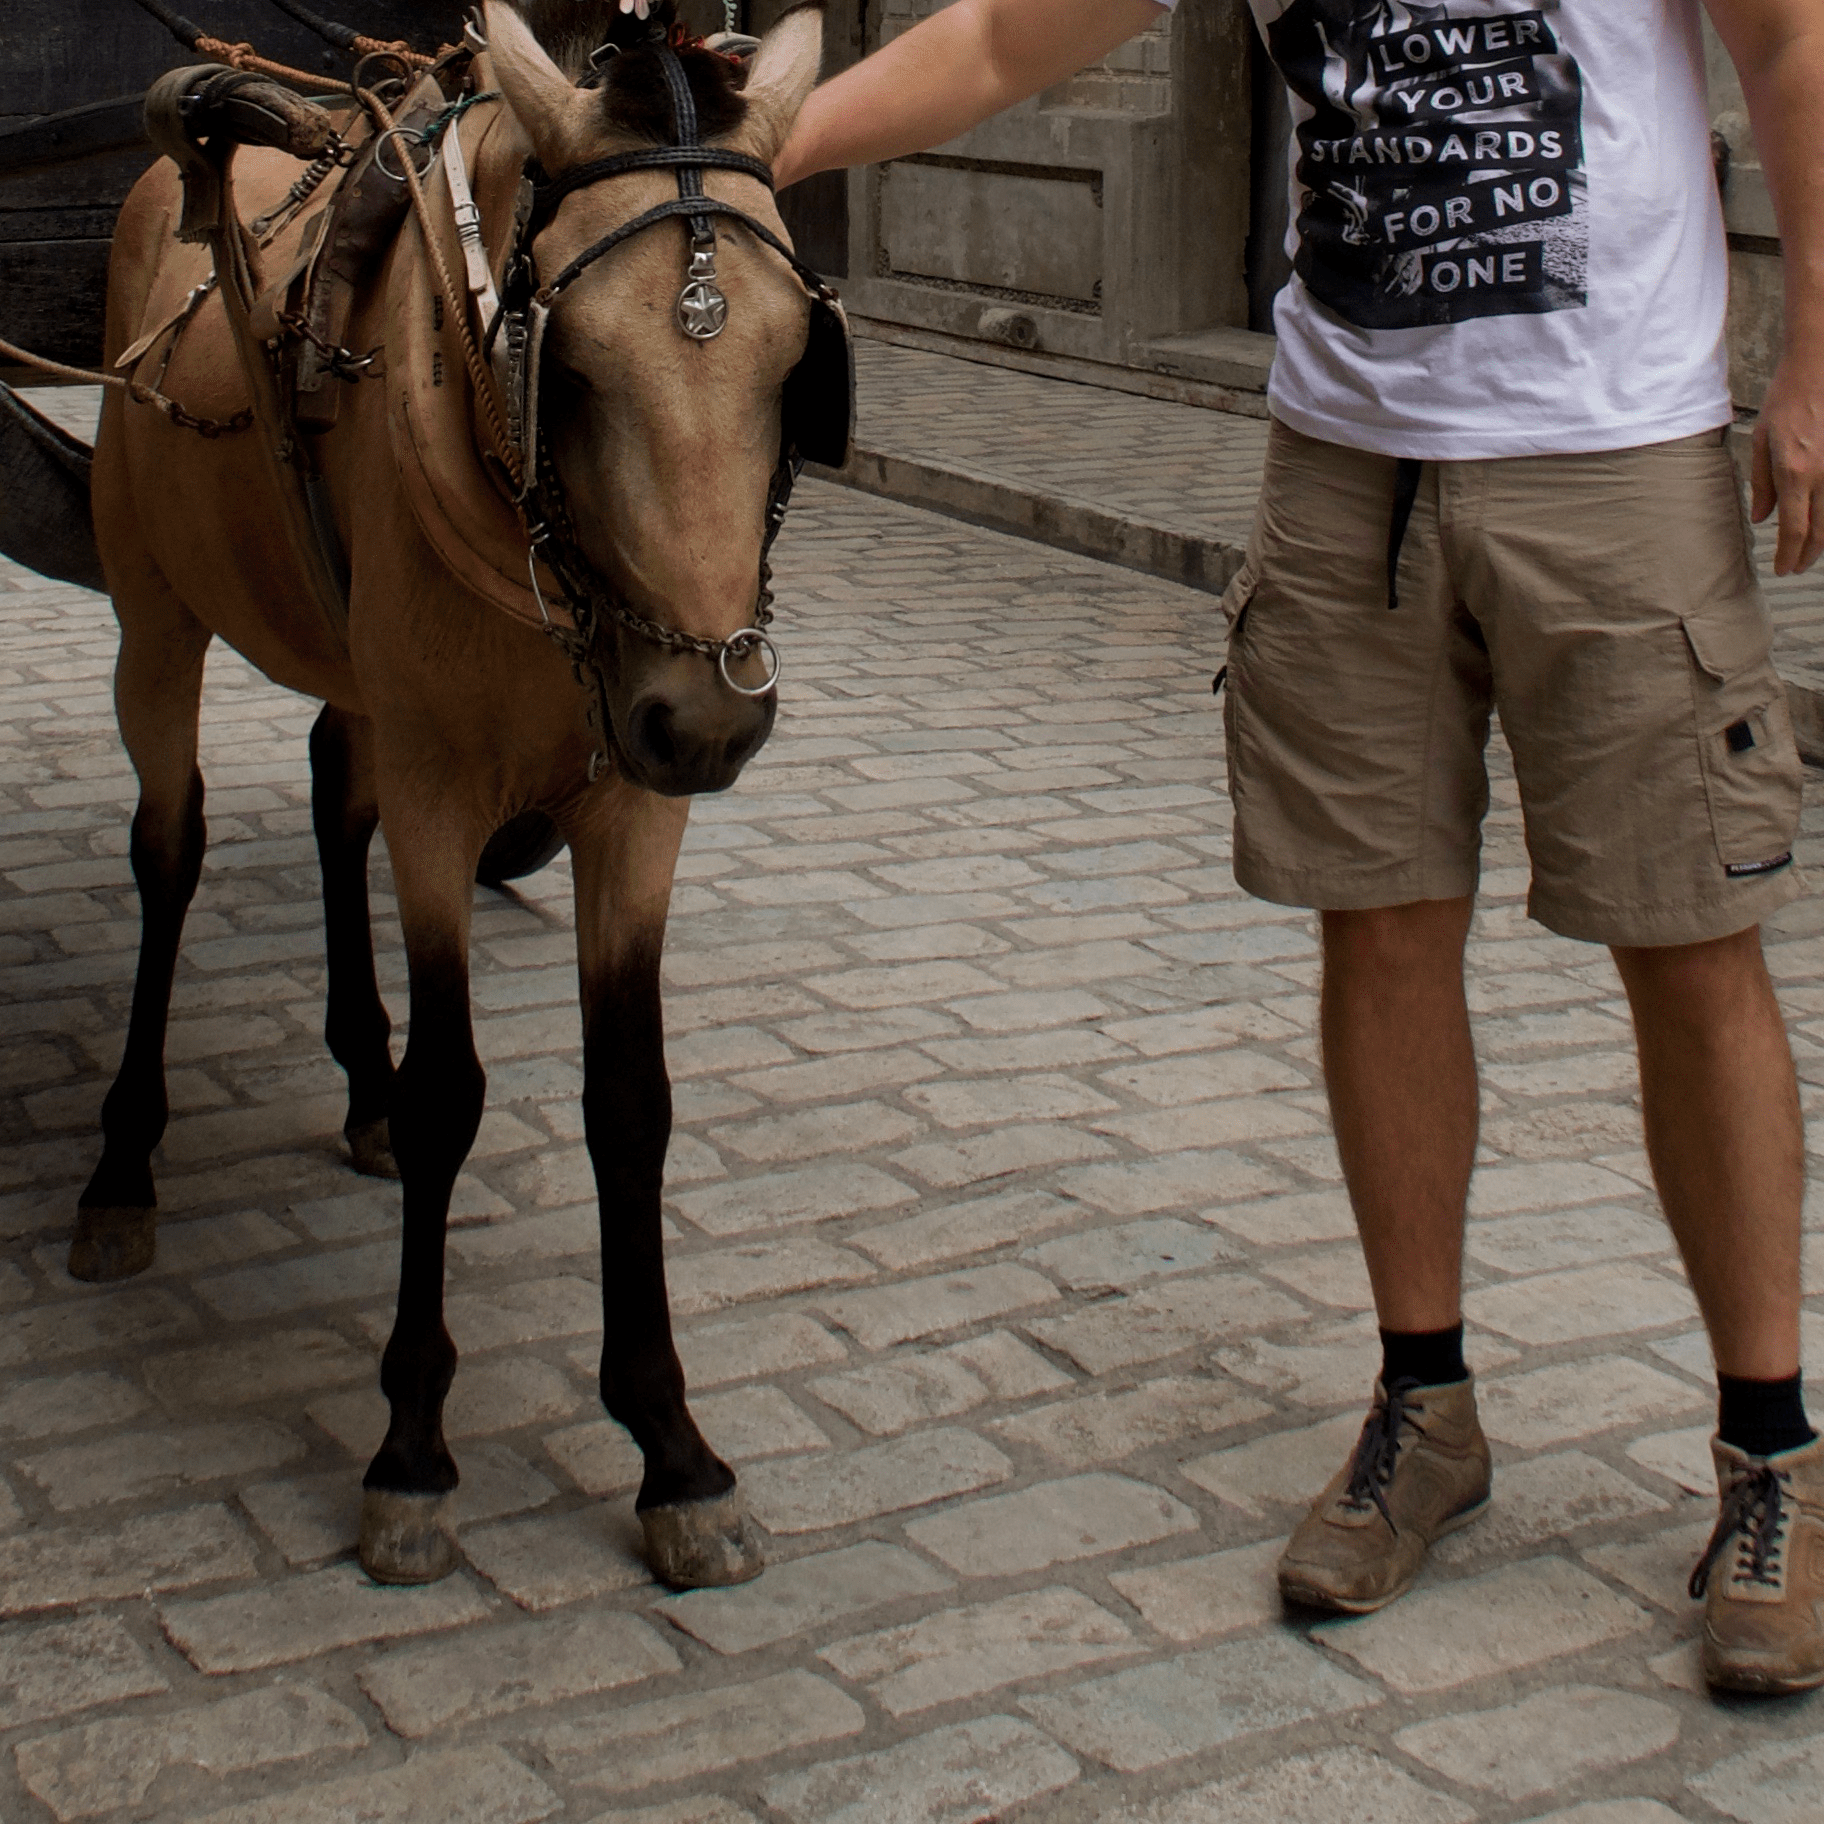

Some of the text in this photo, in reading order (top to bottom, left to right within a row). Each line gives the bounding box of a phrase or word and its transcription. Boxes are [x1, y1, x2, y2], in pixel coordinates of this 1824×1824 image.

[1380, 19, 1542, 72] LOWER
[1396, 71, 1529, 114] YOUR
[1311, 129, 1563, 164] STANDARDS
[1383, 176, 1560, 244] FOR NO
[1428, 251, 1528, 294] ONE
